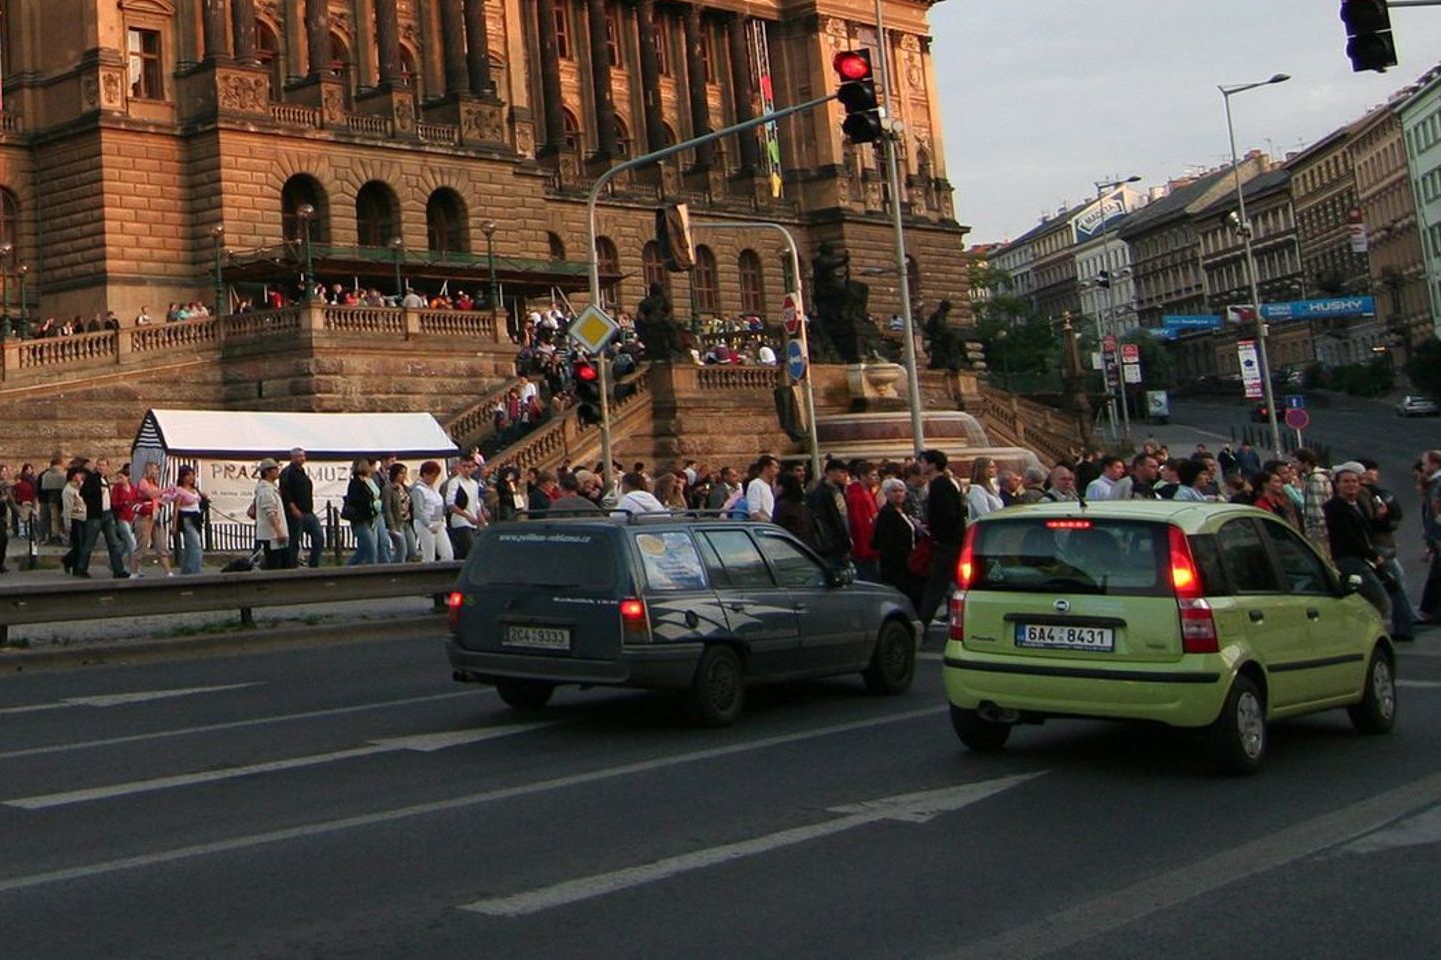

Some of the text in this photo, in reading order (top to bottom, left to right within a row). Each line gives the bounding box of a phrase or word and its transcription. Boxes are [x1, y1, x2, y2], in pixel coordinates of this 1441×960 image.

[1309, 299, 1363, 312] HUSKY
[1028, 626, 1055, 642] 6A4
[1066, 628, 1105, 645] 8431
